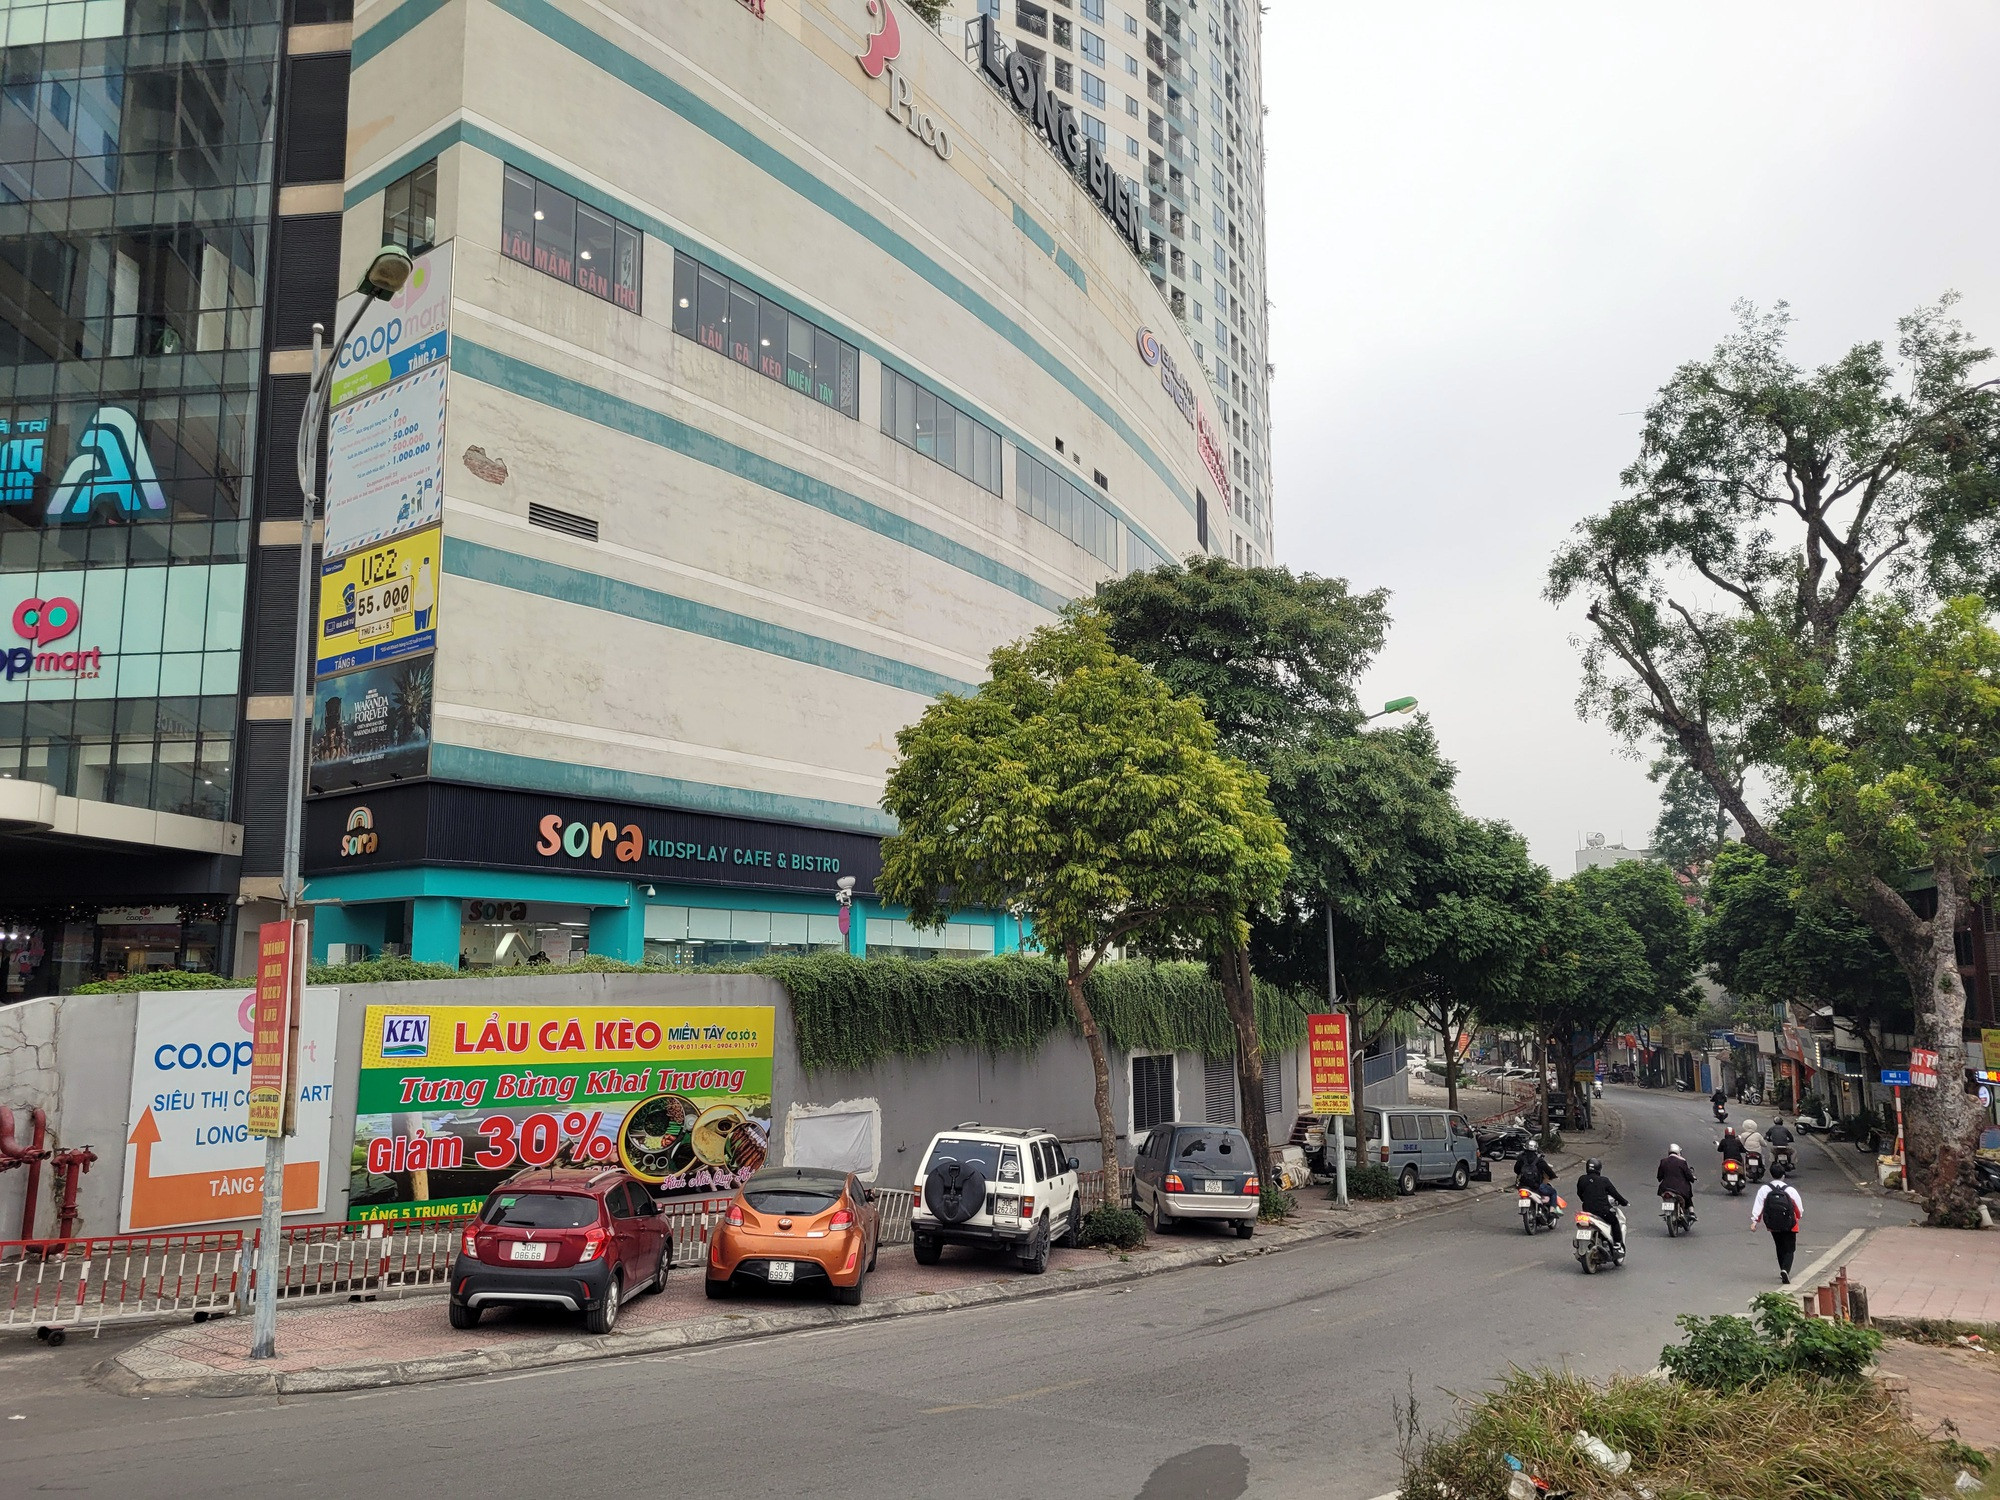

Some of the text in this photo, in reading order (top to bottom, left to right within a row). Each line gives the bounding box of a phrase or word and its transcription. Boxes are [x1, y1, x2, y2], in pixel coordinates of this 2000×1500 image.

[979, 13, 1080, 167] LONG
[393, 423, 419, 441] 50.000
[393, 442, 430, 466] 1.000.000
[358, 584, 409, 617] 55.000
[354, 696, 389, 712] WAKANDA
[354, 707, 389, 723] FOREVER
[341, 831, 379, 857] sora
[536, 814, 840, 874] sora KIDSPLAY CAFE & BISTRO
[469, 900, 526, 921] sora
[385, 1019, 427, 1043] KEN
[454, 1012, 530, 1054] LẨU
[538, 1018, 586, 1052] CÁ
[594, 1018, 662, 1051] KÈO
[704, 1024, 726, 1041] TÂY
[752, 1032, 757, 1041] 2
[399, 1068, 747, 1107] Tưng Bừng Khai Trương
[153, 1089, 195, 1111] SIÊU
[201, 1090, 229, 1112] THỊ
[195, 1124, 248, 1146] LONG
[367, 1111, 613, 1174] Giảm 30%
[209, 1176, 255, 1197] TẦNG
[415, 1204, 458, 1218] TRUNG
[514, 1251, 541, 1260] 086.68
[775, 1262, 789, 1271] 30E
